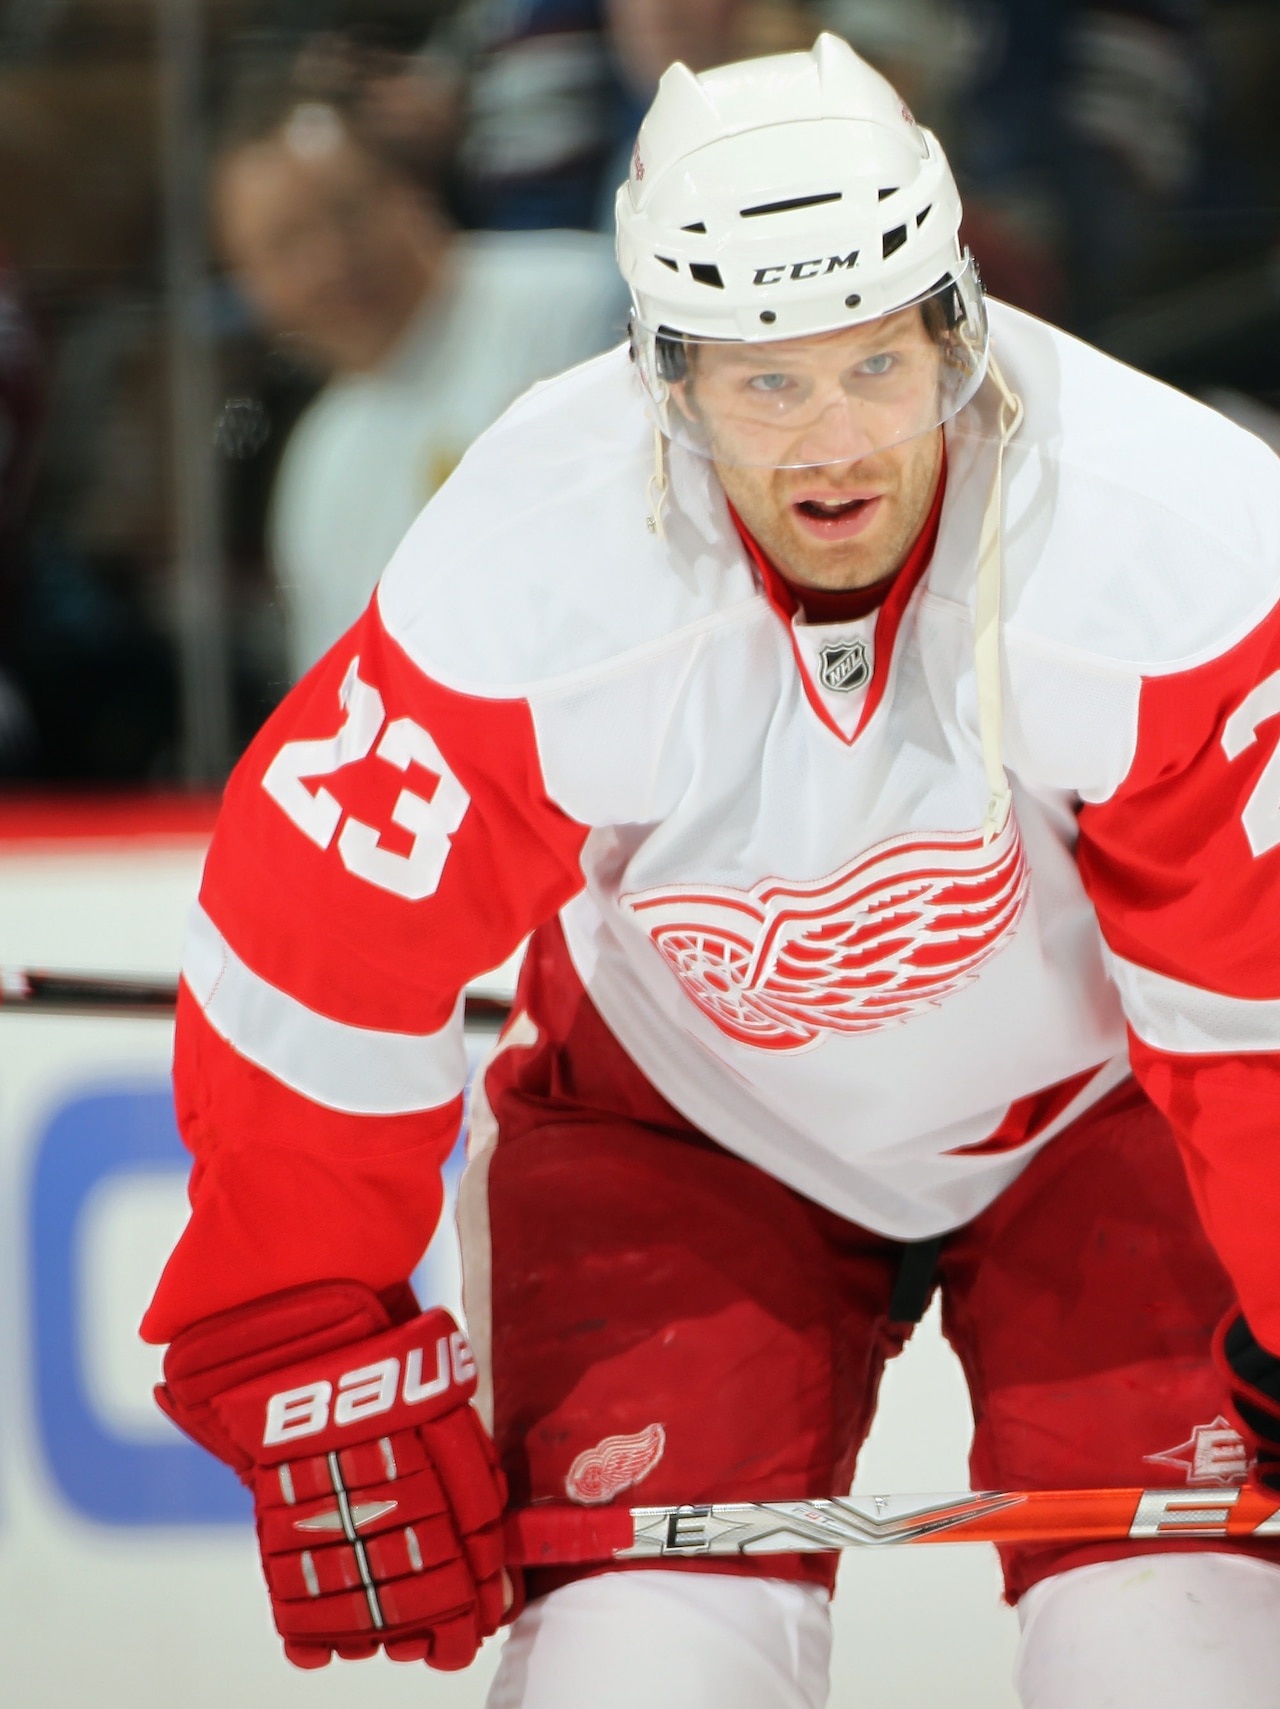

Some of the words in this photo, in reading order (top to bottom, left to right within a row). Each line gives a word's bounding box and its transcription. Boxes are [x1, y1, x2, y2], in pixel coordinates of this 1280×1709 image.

[752, 249, 860, 287] CCM
[829, 652, 862, 687] NHL
[261, 654, 473, 903] 23
